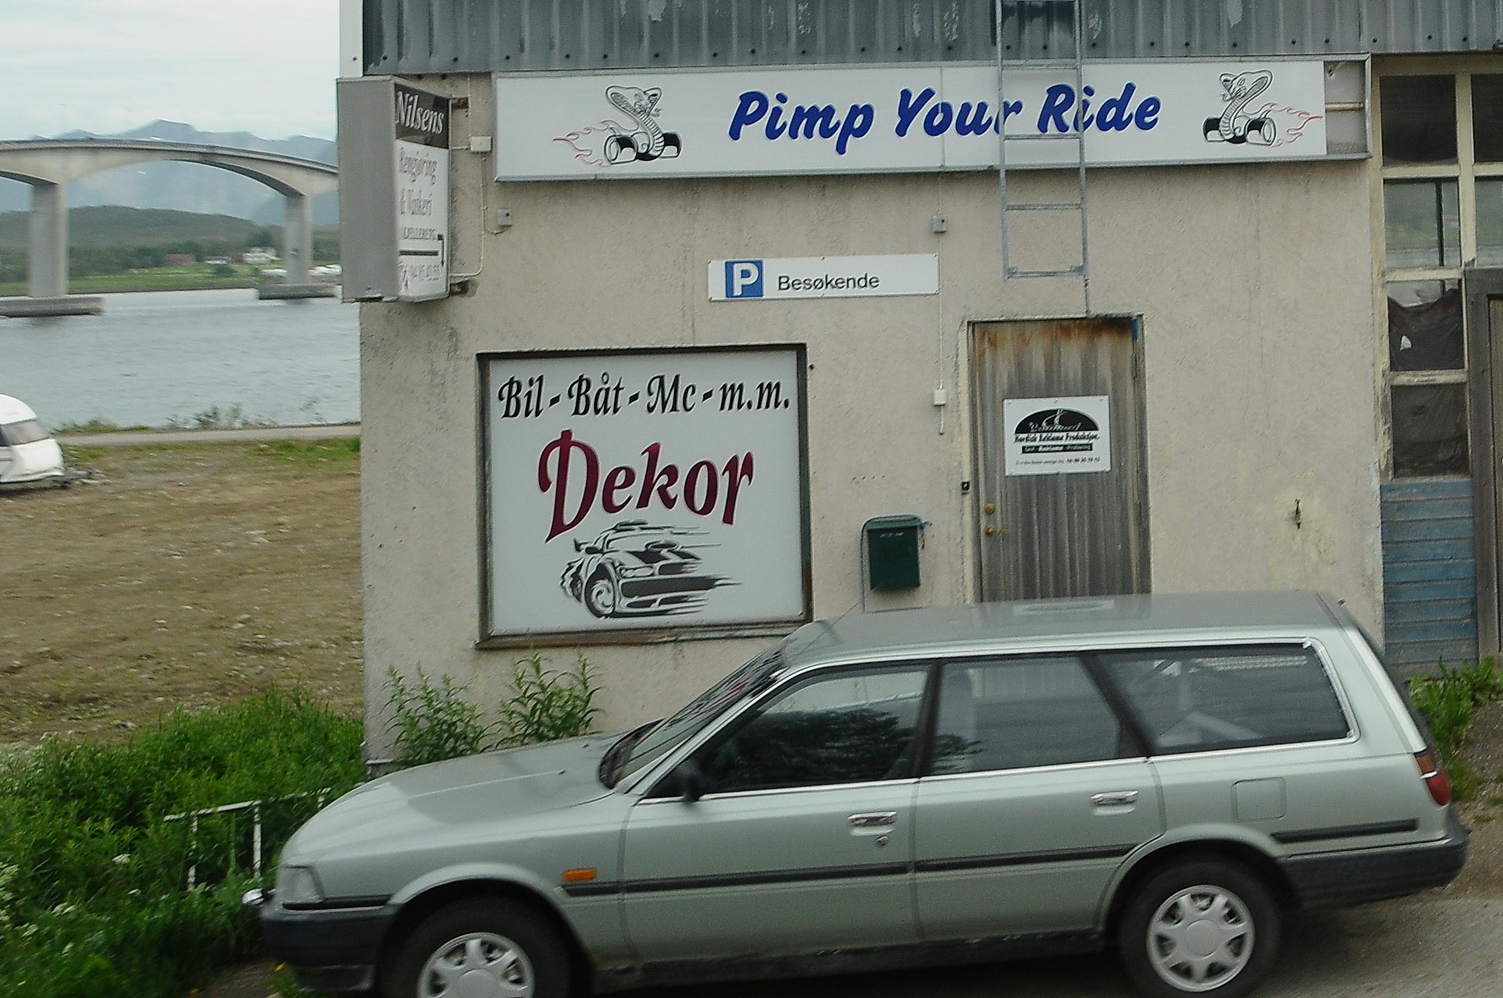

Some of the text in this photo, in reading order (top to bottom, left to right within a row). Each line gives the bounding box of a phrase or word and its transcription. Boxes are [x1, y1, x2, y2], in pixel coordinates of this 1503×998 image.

[395, 90, 446, 135] Nilsens
[728, 81, 1162, 156] Pimp Your Ride
[777, 272, 881, 291] Besøkende
[537, 428, 755, 544] Dekor
